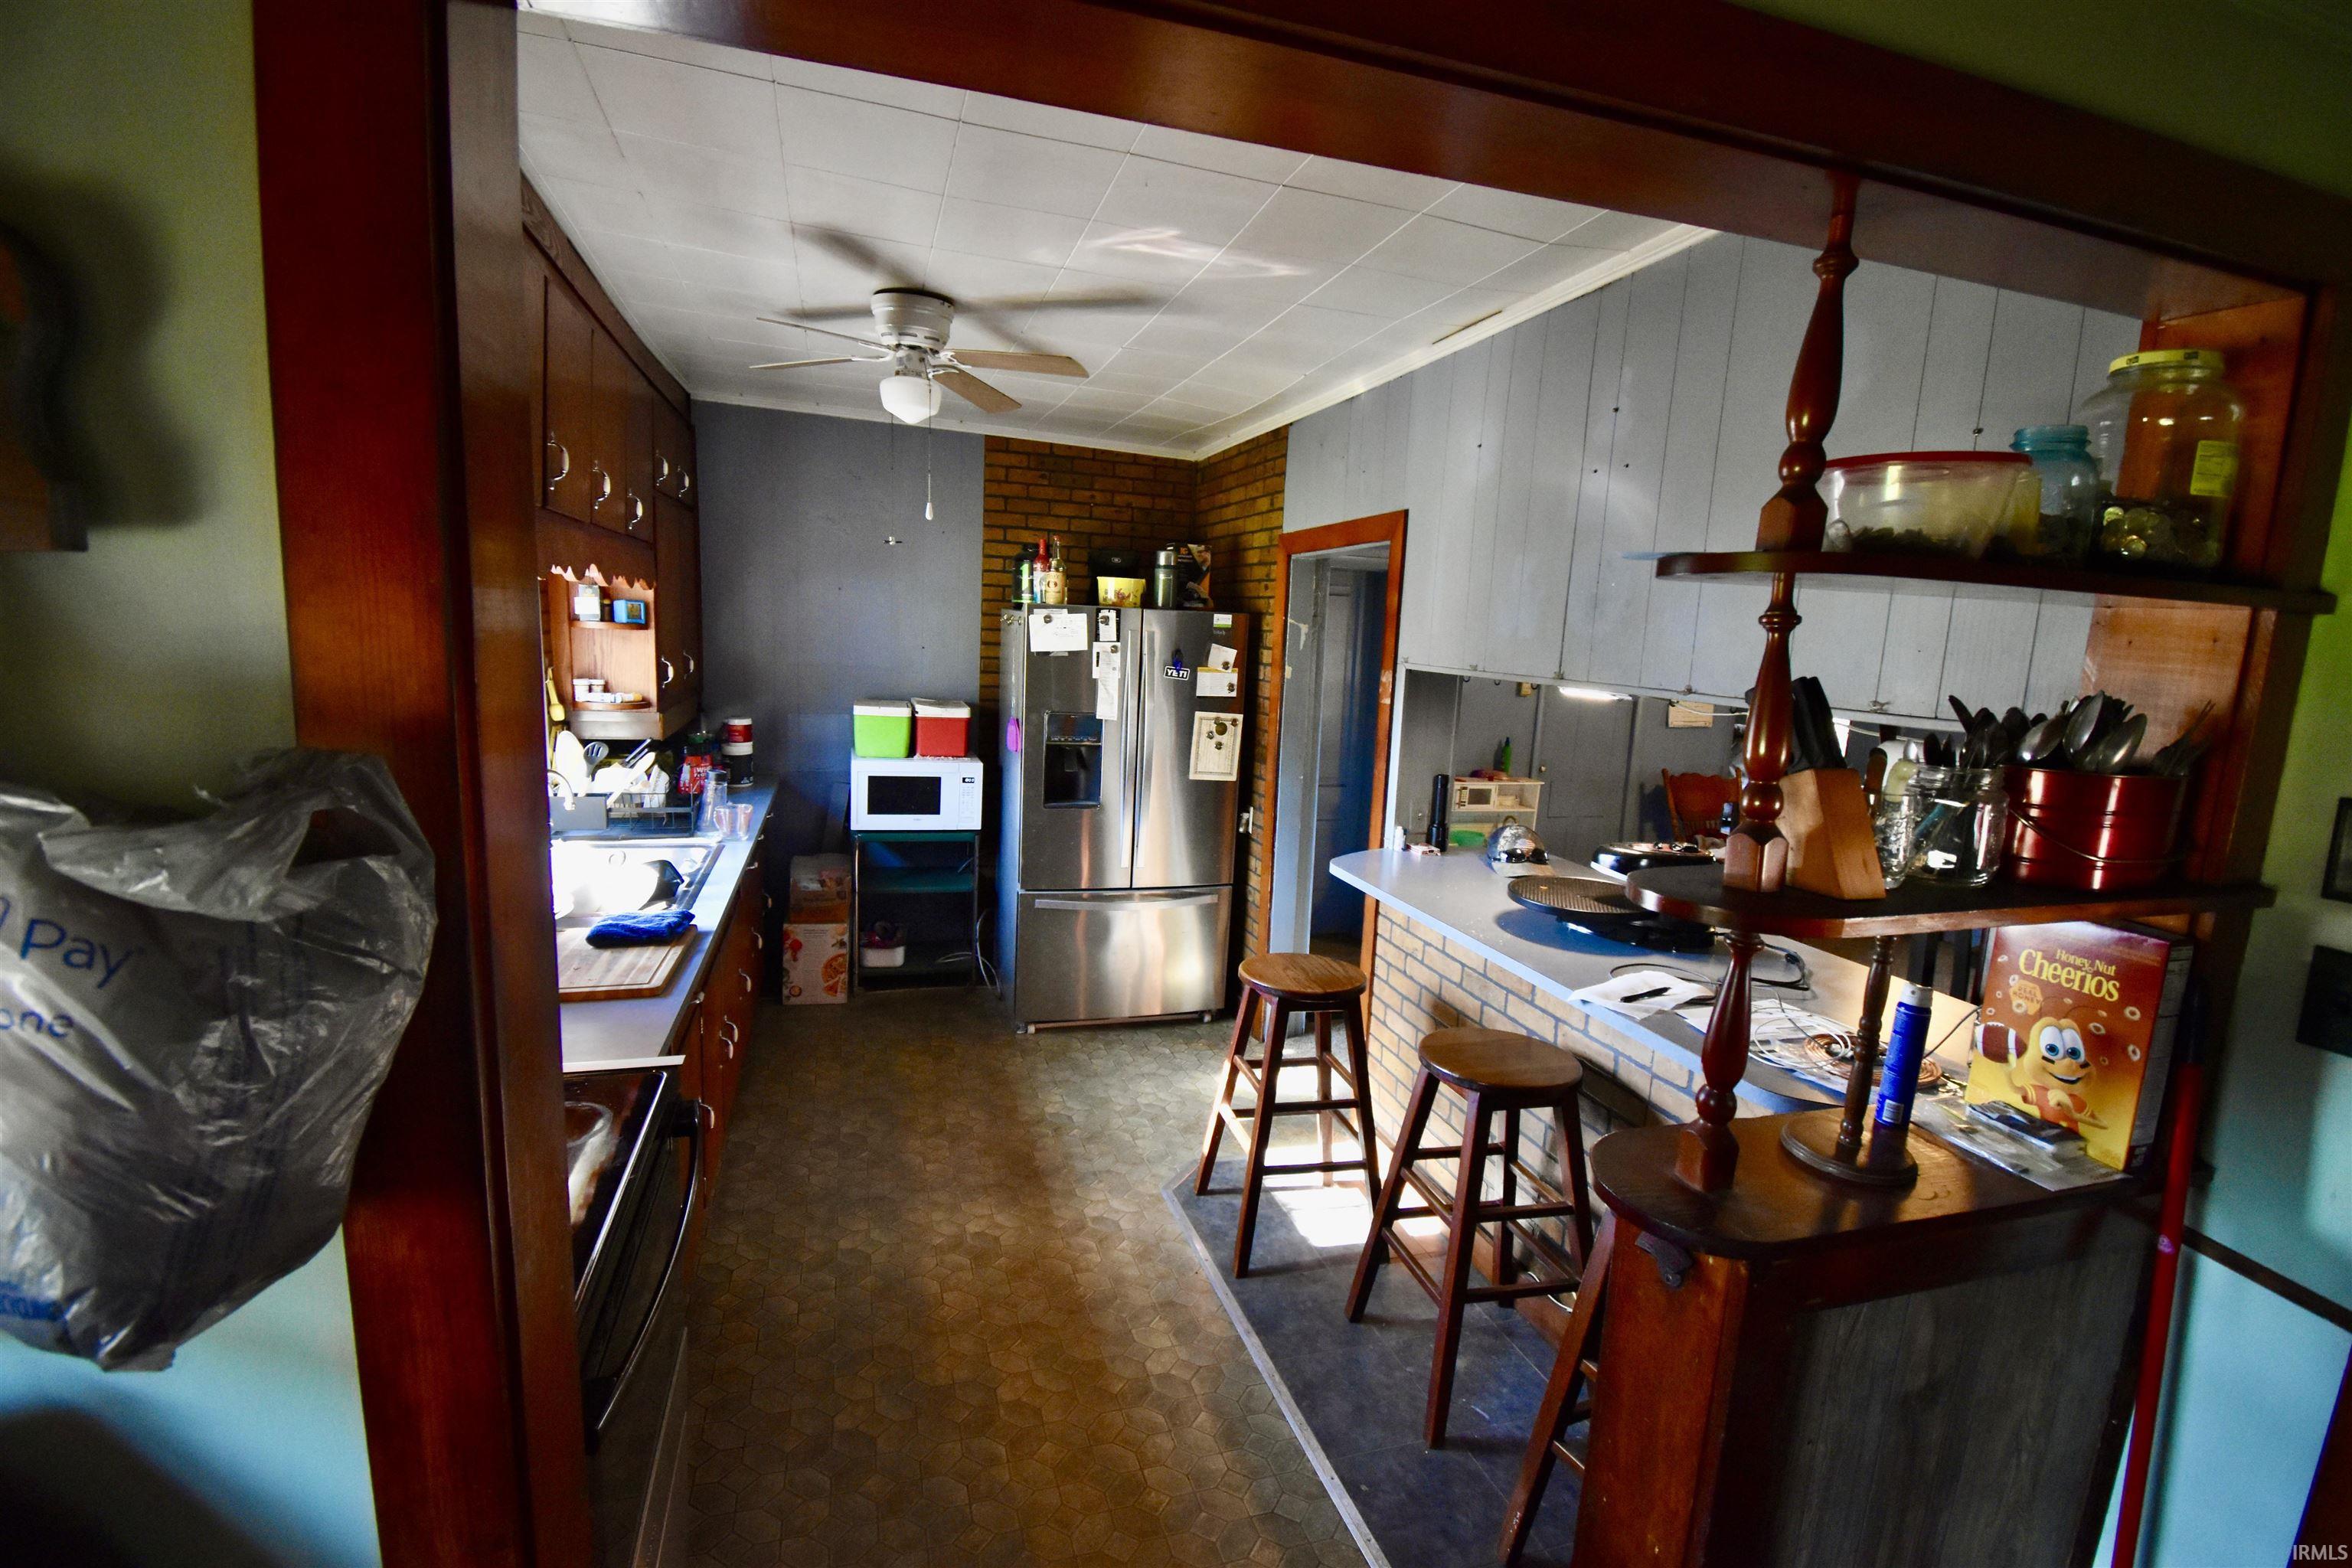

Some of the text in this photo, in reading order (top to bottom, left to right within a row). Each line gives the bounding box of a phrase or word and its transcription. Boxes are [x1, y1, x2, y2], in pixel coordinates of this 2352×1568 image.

[1166, 668, 1187, 678] YETI
[21, 918, 134, 990] Pay
[2056, 949, 2092, 971] Honey
[2093, 959, 2117, 977] Nut
[2018, 949, 2120, 1002] Cheerios
